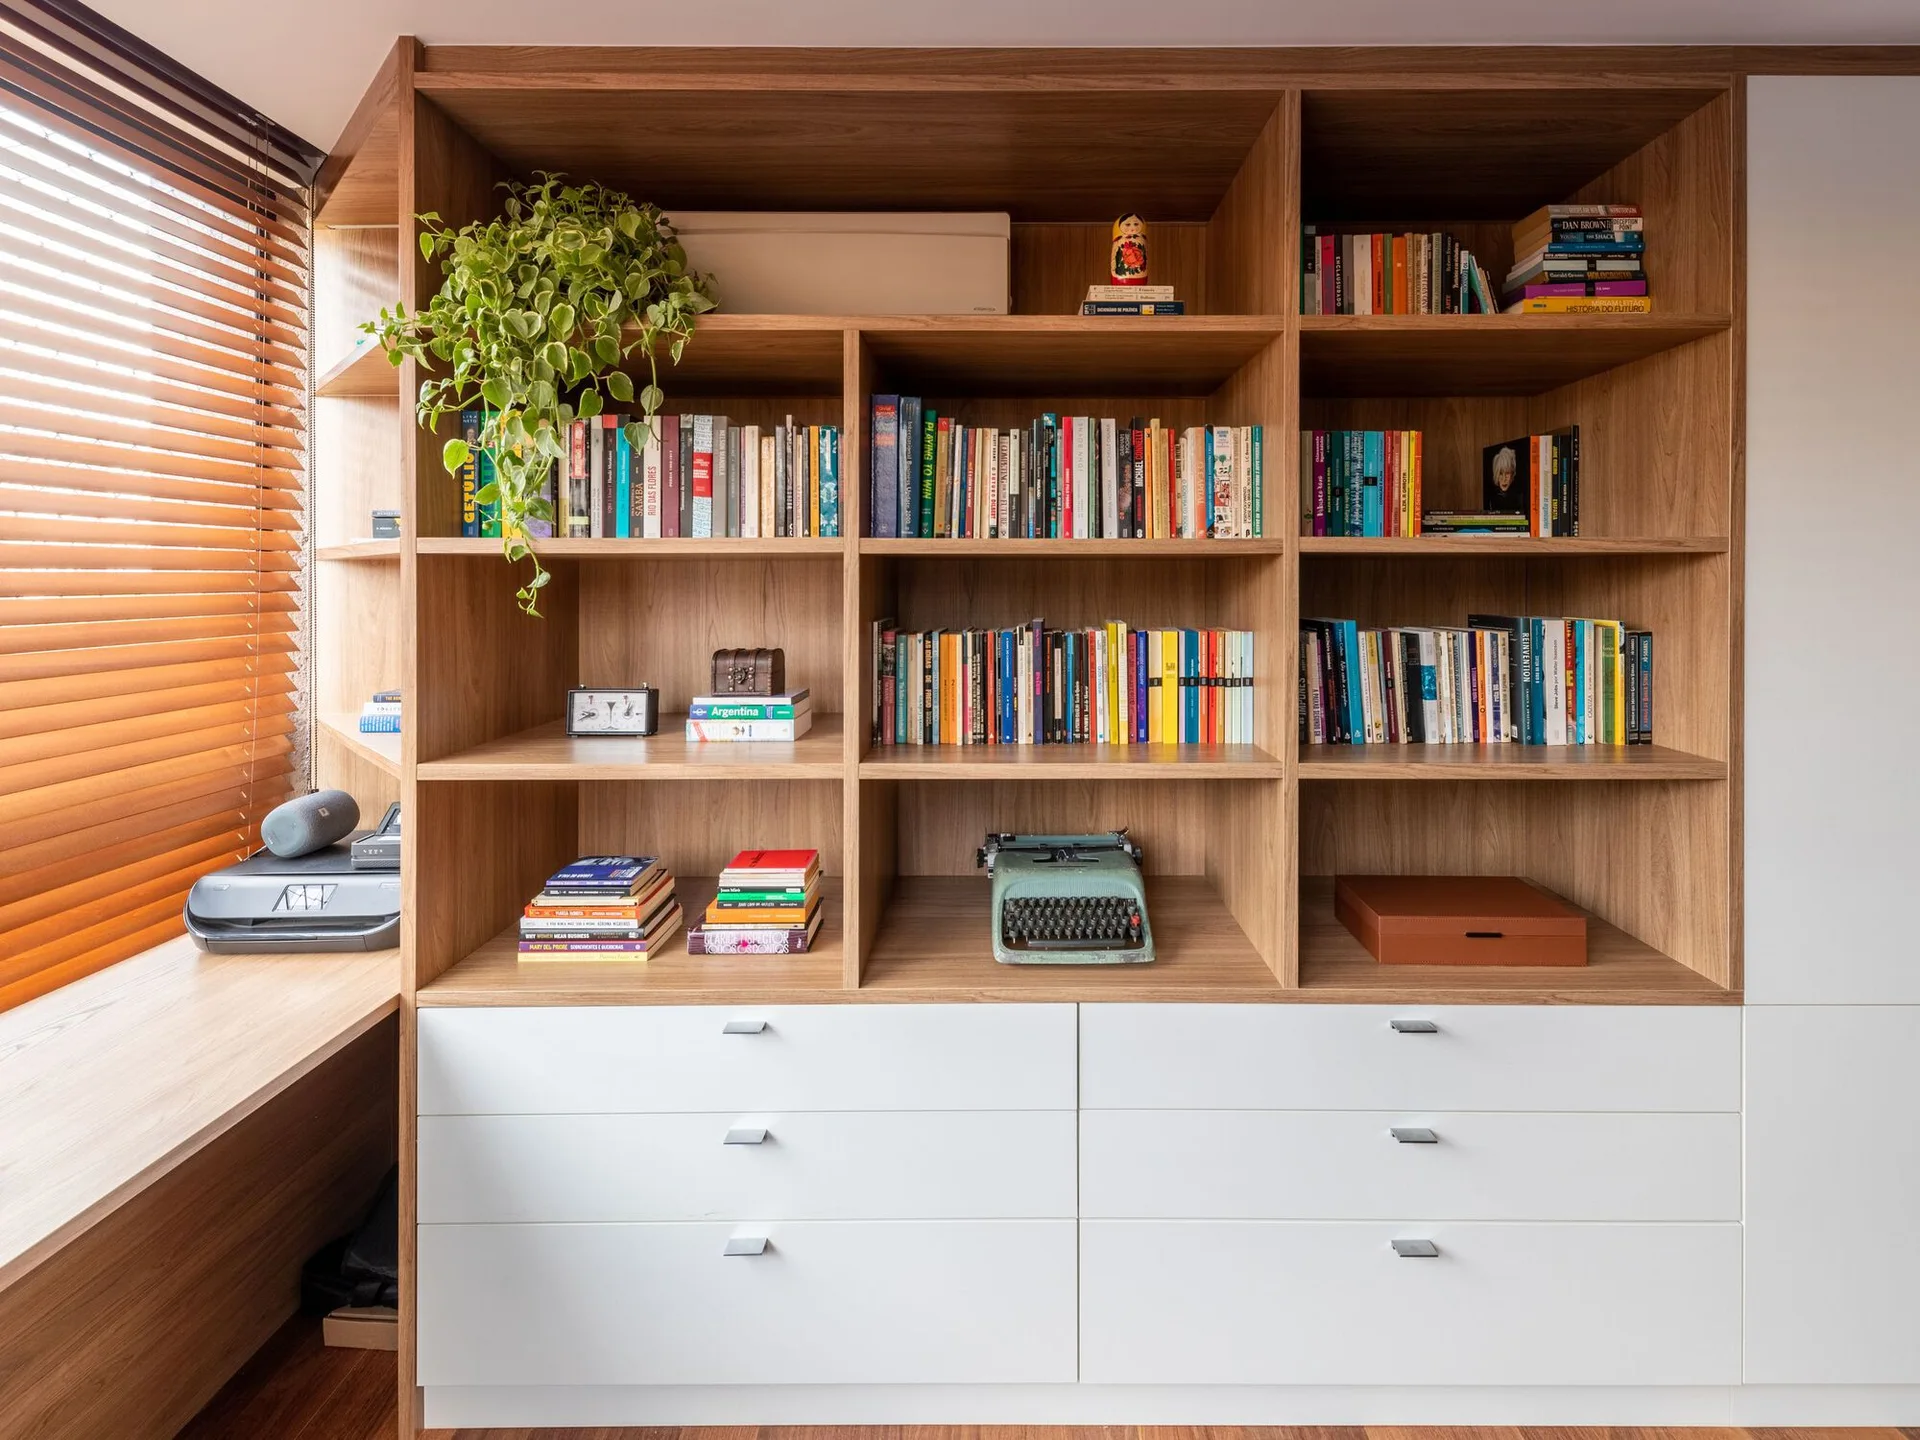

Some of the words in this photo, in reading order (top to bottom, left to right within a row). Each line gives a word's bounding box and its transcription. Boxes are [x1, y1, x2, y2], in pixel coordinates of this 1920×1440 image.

[1562, 221, 1579, 229] DAN
[1580, 221, 1606, 229] BROWN
[925, 421, 934, 461] PLAYING
[1135, 430, 1143, 459] CONNELLY
[923, 463, 933, 476] TO
[999, 444, 1008, 483] COMPETING
[1135, 461, 1143, 487] MICHAEL
[464, 453, 475, 522] GETÚLIO
[648, 466, 656, 489] FLORES
[922, 479, 932, 499] WIN
[635, 483, 643, 517] SAMBA
[648, 491, 656, 503] DAS
[648, 504, 656, 515] RIO
[1000, 500, 1008, 526] FUTURE
[1522, 632, 1530, 682] REINVENTION
[711, 707, 759, 717] Argentina
